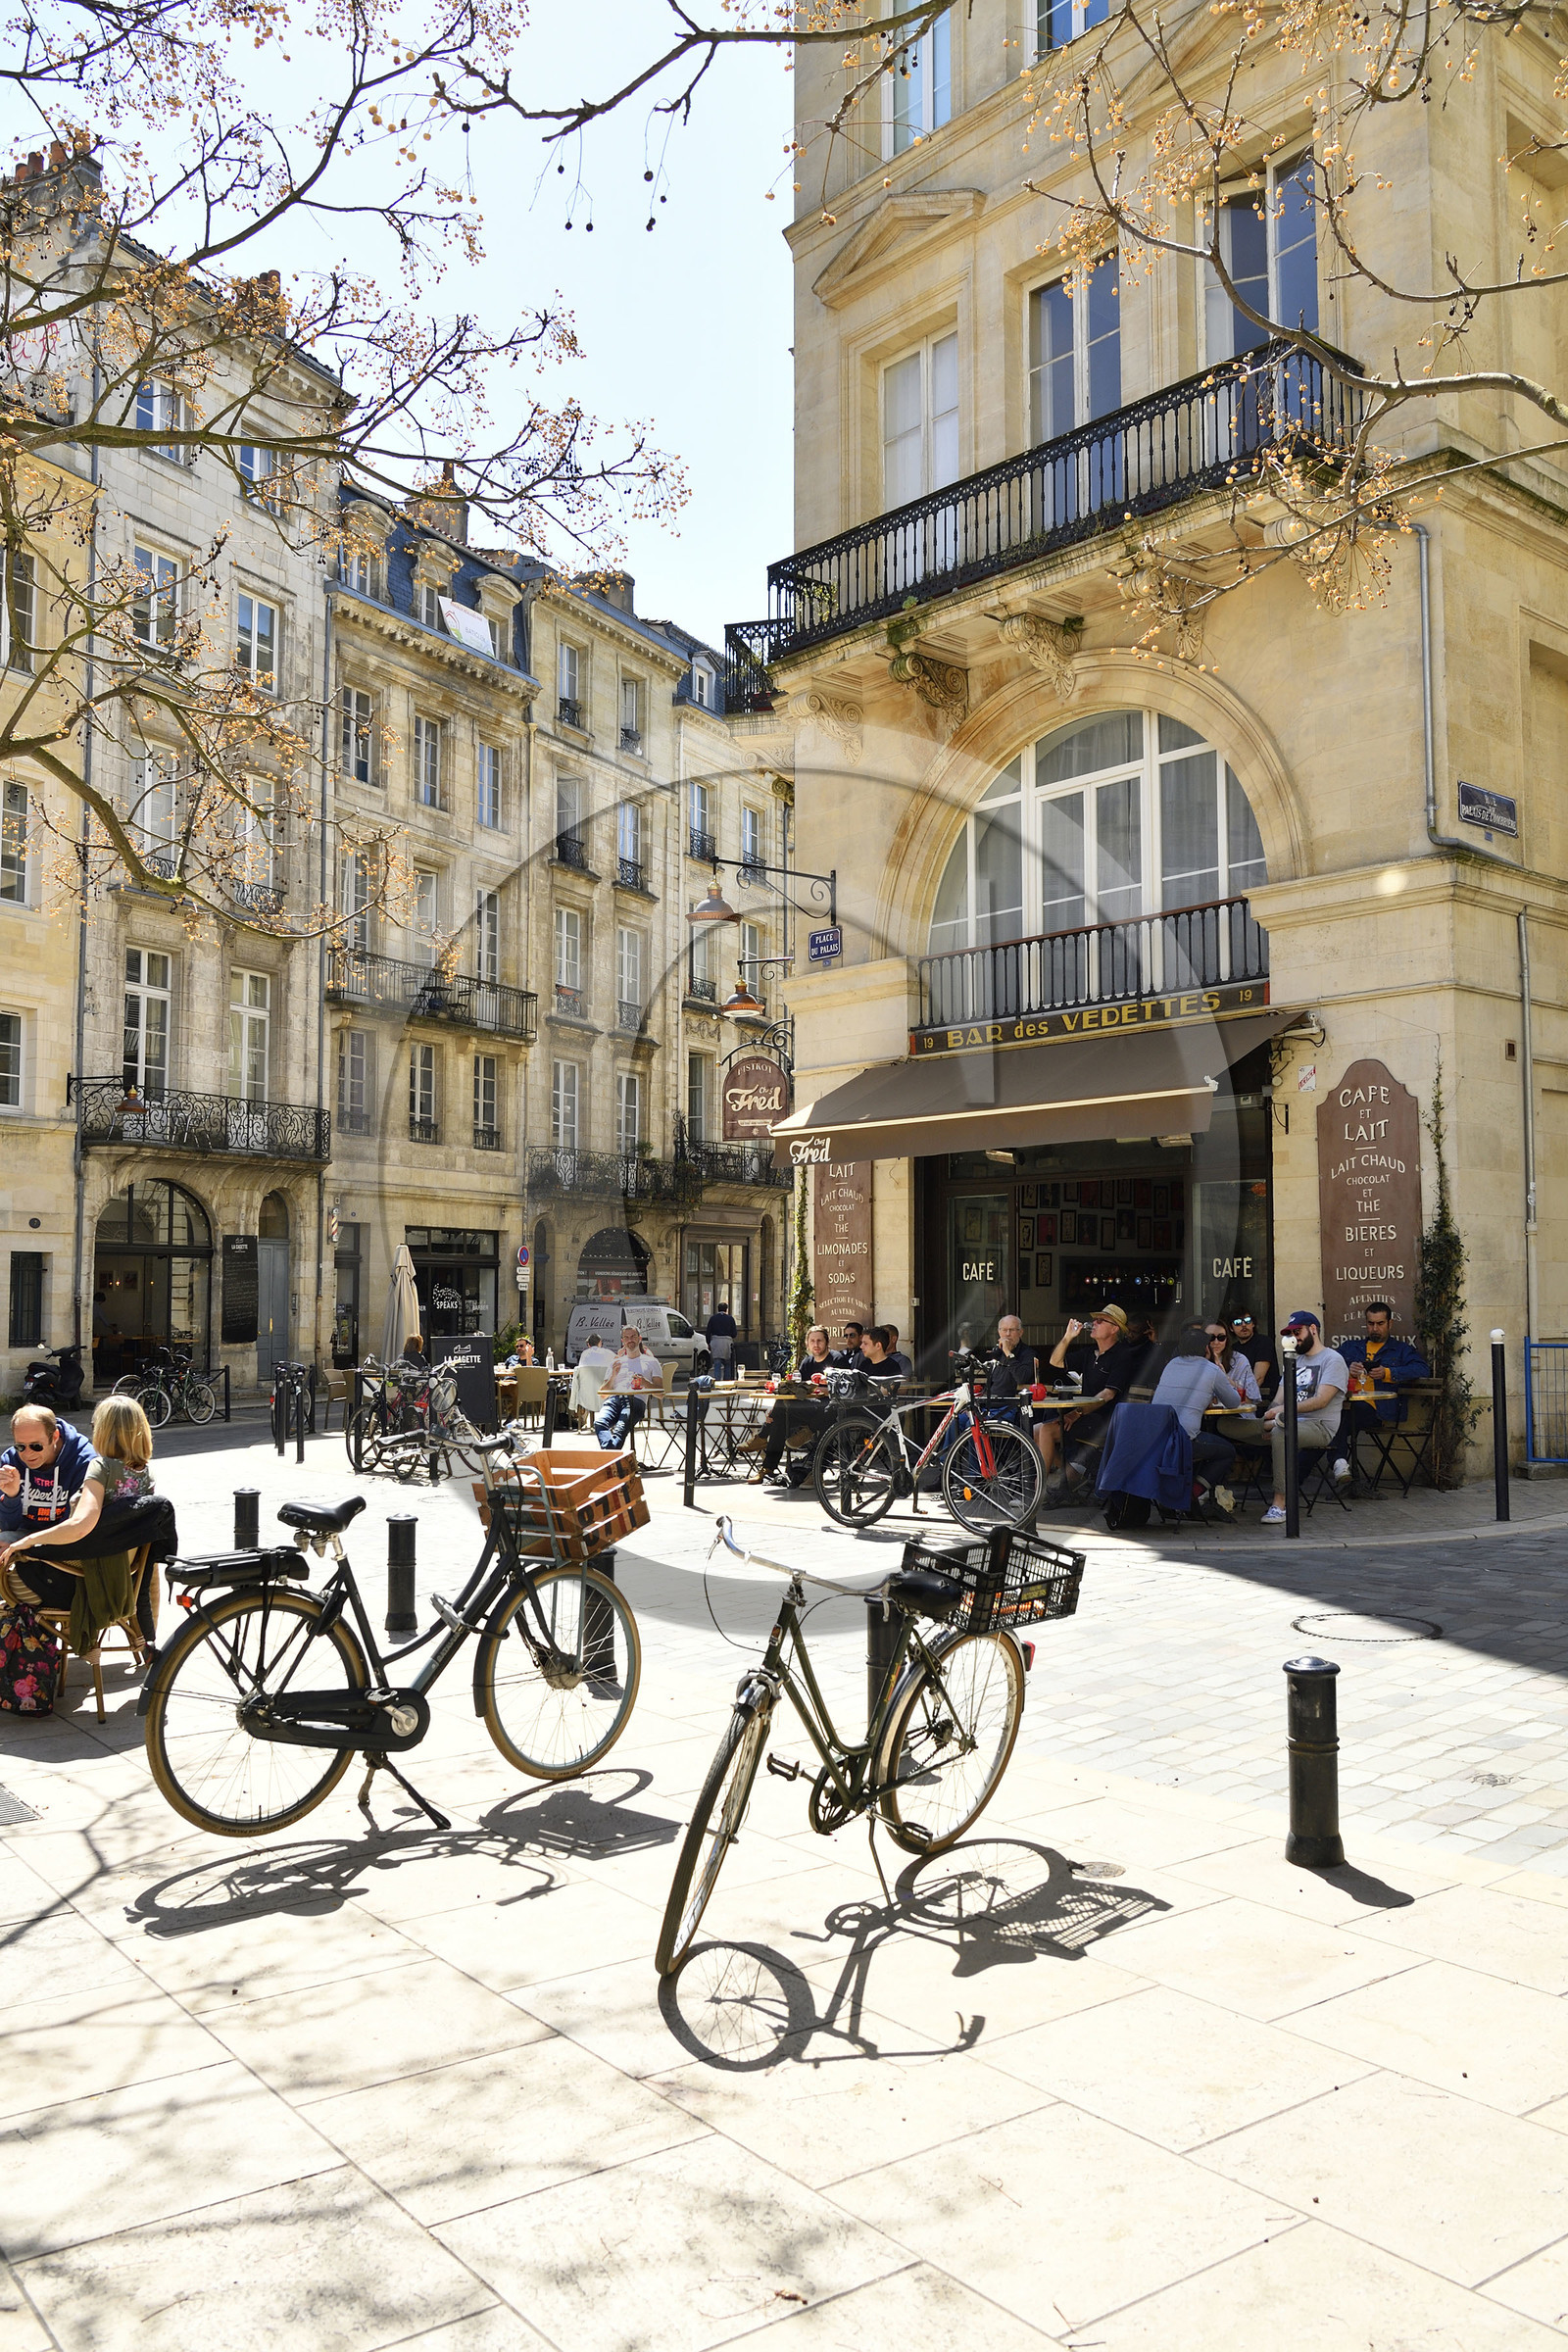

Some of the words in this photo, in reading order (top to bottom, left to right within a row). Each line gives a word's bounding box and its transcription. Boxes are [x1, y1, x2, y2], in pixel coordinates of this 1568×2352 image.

[815, 933, 834, 945] PLACE
[810, 947, 819, 956] DU
[820, 943, 839, 955] PALAIS
[923, 1037, 934, 1049] 19
[947, 1025, 1004, 1049] BAR
[1014, 1021, 1049, 1039] des
[1061, 992, 1221, 1032] VEDETTES
[1239, 989, 1253, 1003] 19
[737, 1062, 772, 1076] BISTROT
[725, 1084, 783, 1112] Fred
[1339, 1085, 1391, 1107] CAFE
[1359, 1108, 1372, 1119] ET
[1344, 1119, 1390, 1142] LAIT
[789, 1136, 832, 1164] Fred
[828, 1161, 856, 1178] LAIT
[1331, 1156, 1357, 1180] LAIT
[1360, 1154, 1405, 1174] CHAUD
[1346, 1174, 1391, 1186] CHOCOLAT
[820, 1190, 837, 1206] LAIT
[838, 1188, 864, 1203] CHAUD
[1362, 1188, 1373, 1198] ET
[828, 1203, 855, 1212] CHOCOLAT
[1355, 1199, 1381, 1213] THE
[834, 1222, 850, 1233] THE
[1345, 1224, 1397, 1242] BIERES
[817, 1242, 868, 1255] LIMONADES
[1364, 1248, 1375, 1257] ET
[962, 1260, 994, 1281] CAFÉ
[1212, 1255, 1252, 1278] CAFÉ
[1336, 1264, 1405, 1281] LIQUEURS
[827, 1272, 856, 1284] SODAS
[436, 1300, 459, 1310] SPEAKS
[1348, 1294, 1396, 1306] APERITIFS
[590, 1316, 615, 1328] Vallée
[1344, 1313, 1356, 1323] DE
